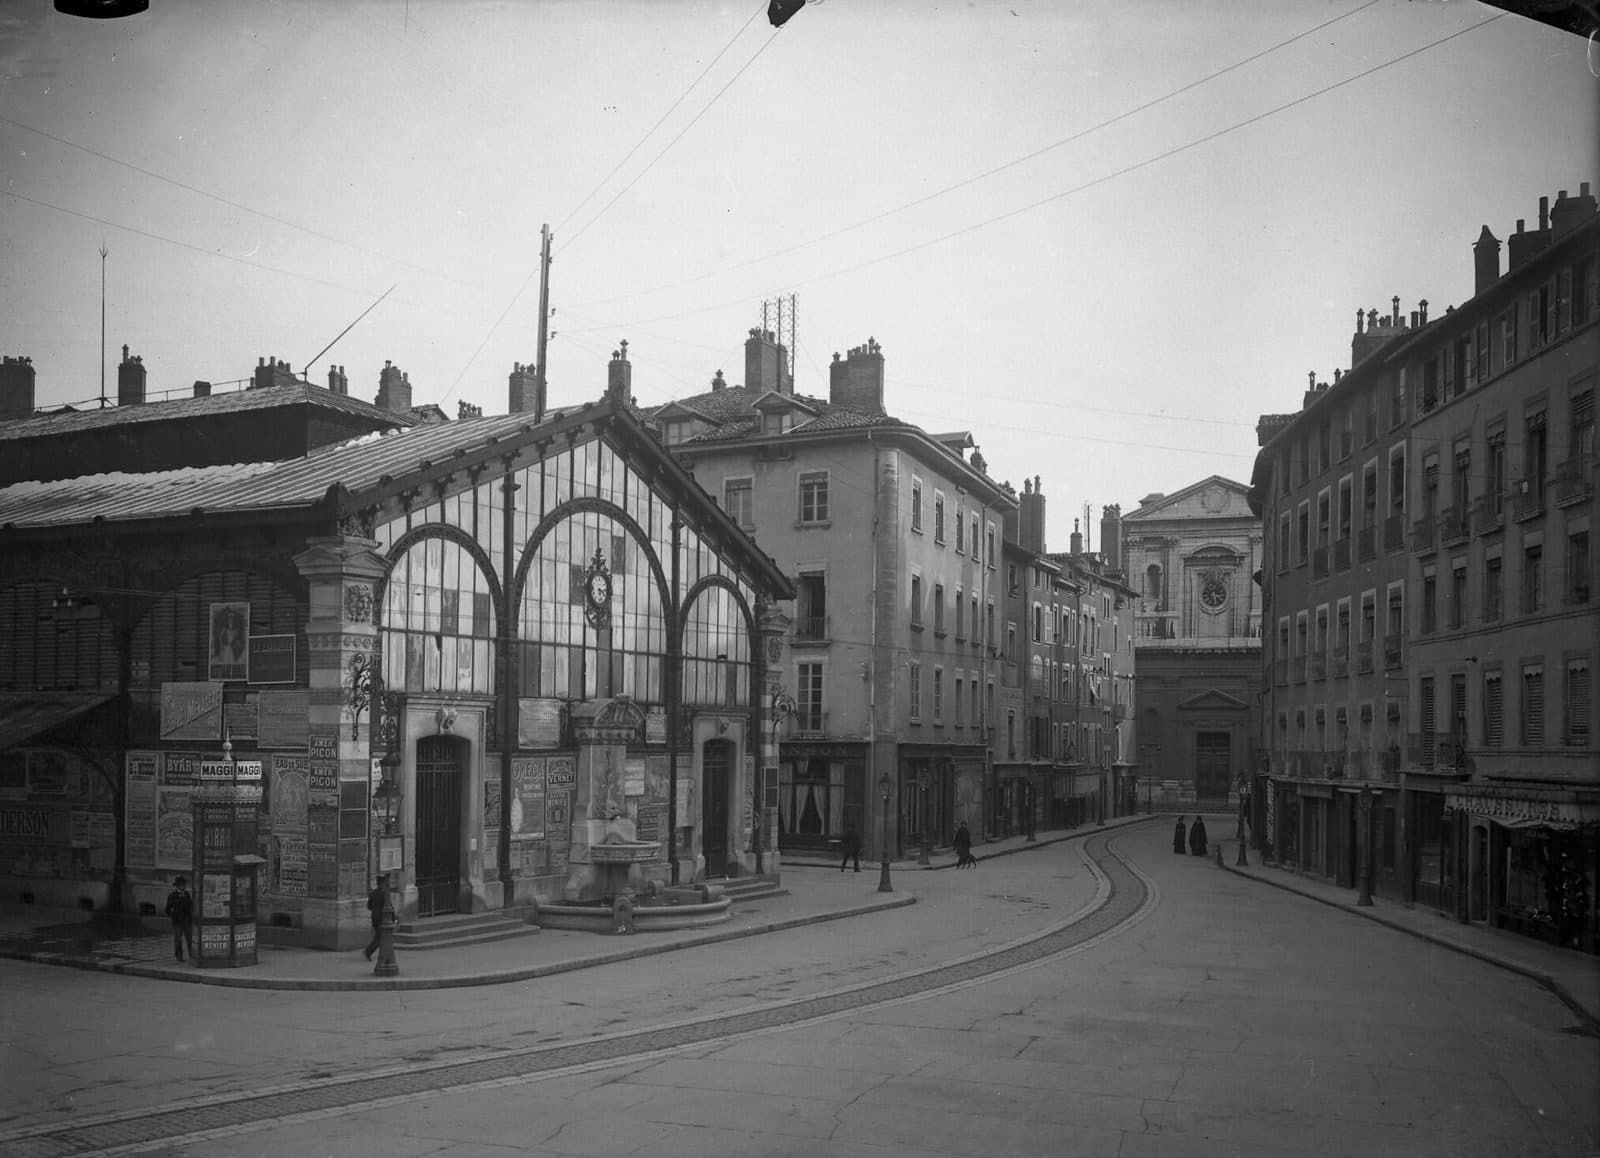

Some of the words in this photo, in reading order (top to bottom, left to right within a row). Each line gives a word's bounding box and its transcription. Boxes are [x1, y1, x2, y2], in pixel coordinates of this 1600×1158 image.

[310, 747, 337, 759] PICON
[167, 758, 192, 772] BYRR
[202, 764, 233, 776] MAGGI
[238, 764, 262, 776] MAGGI
[310, 776, 337, 787] PICON
